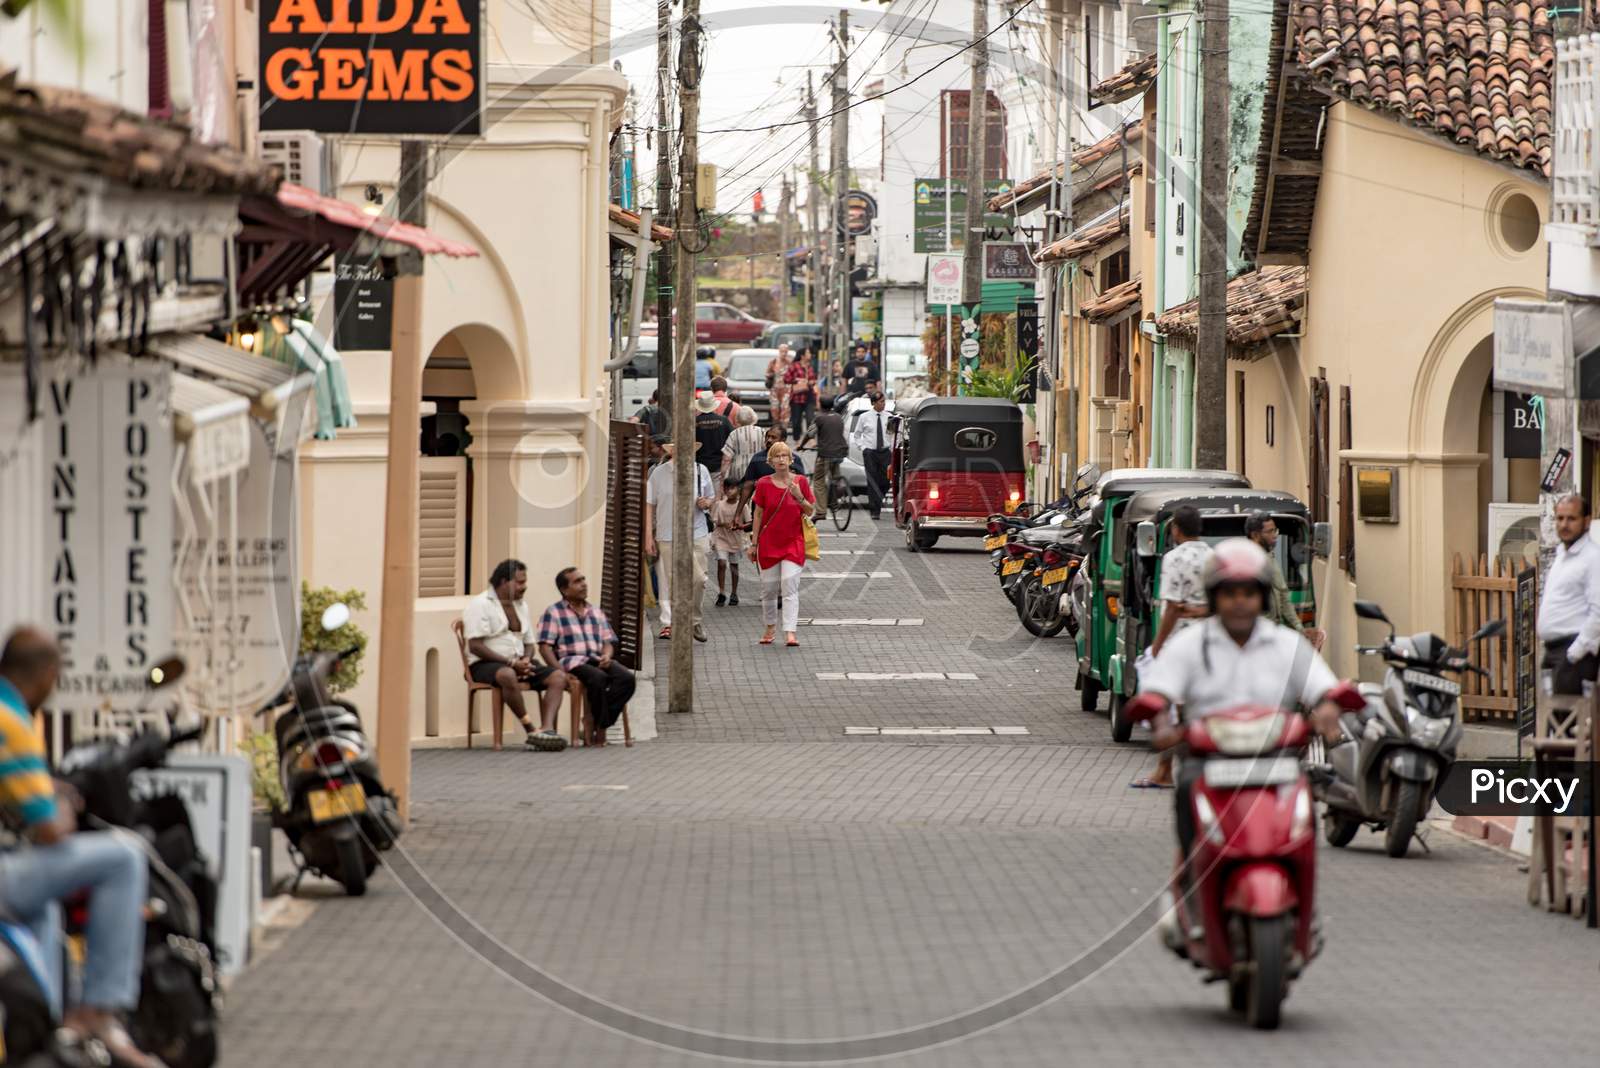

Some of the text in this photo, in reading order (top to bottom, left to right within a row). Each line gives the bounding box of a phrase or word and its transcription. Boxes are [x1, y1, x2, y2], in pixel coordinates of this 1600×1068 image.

[268, 0, 471, 34] AIDA
[265, 47, 474, 102] GEMS
[126, 378, 149, 668] POSTERS
